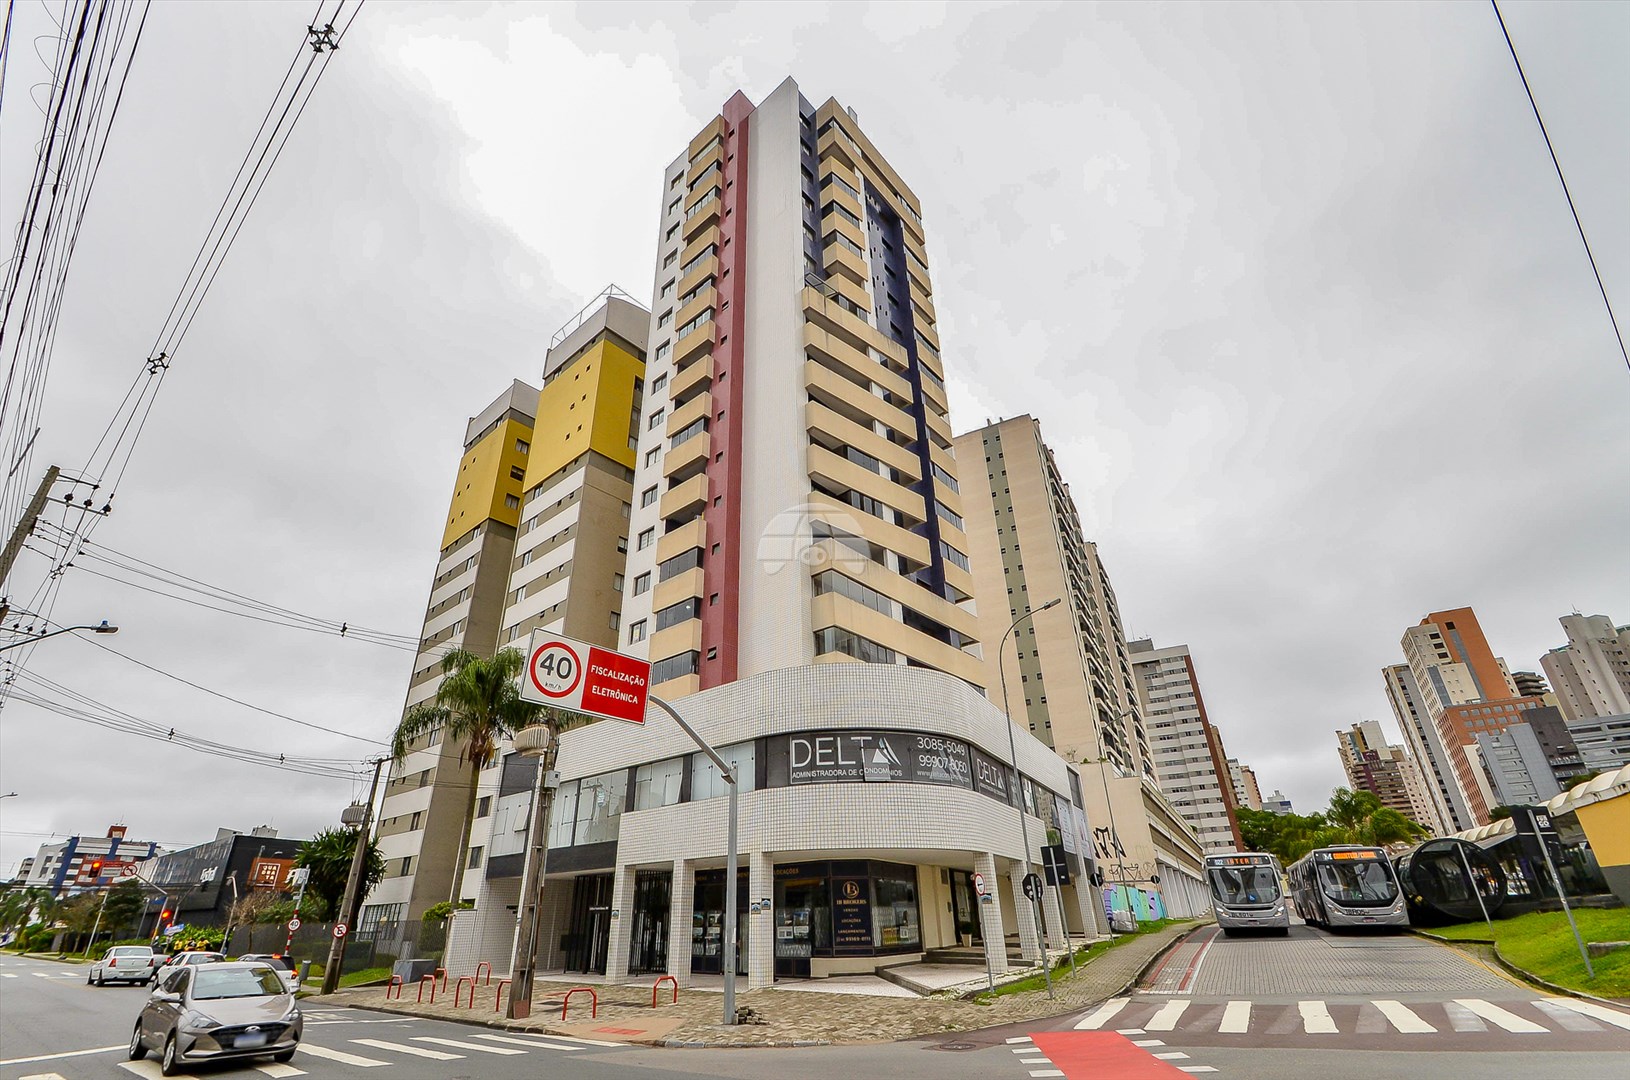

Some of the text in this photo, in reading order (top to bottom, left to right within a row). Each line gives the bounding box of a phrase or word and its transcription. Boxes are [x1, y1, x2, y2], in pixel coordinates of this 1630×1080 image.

[540, 653, 572, 680] 40
[590, 664, 645, 687] FISCALIZAÇÃO
[544, 681, 562, 690] km/h
[591, 685, 638, 705] ELETRÔNICA
[792, 736, 902, 768] DELTA
[917, 736, 965, 756] 3085-5049
[792, 768, 847, 779] ADMINISTRADORA
[848, 768, 858, 776] DE
[1226, 857, 1249, 865] INTER
[290, 919, 299, 927] 40
